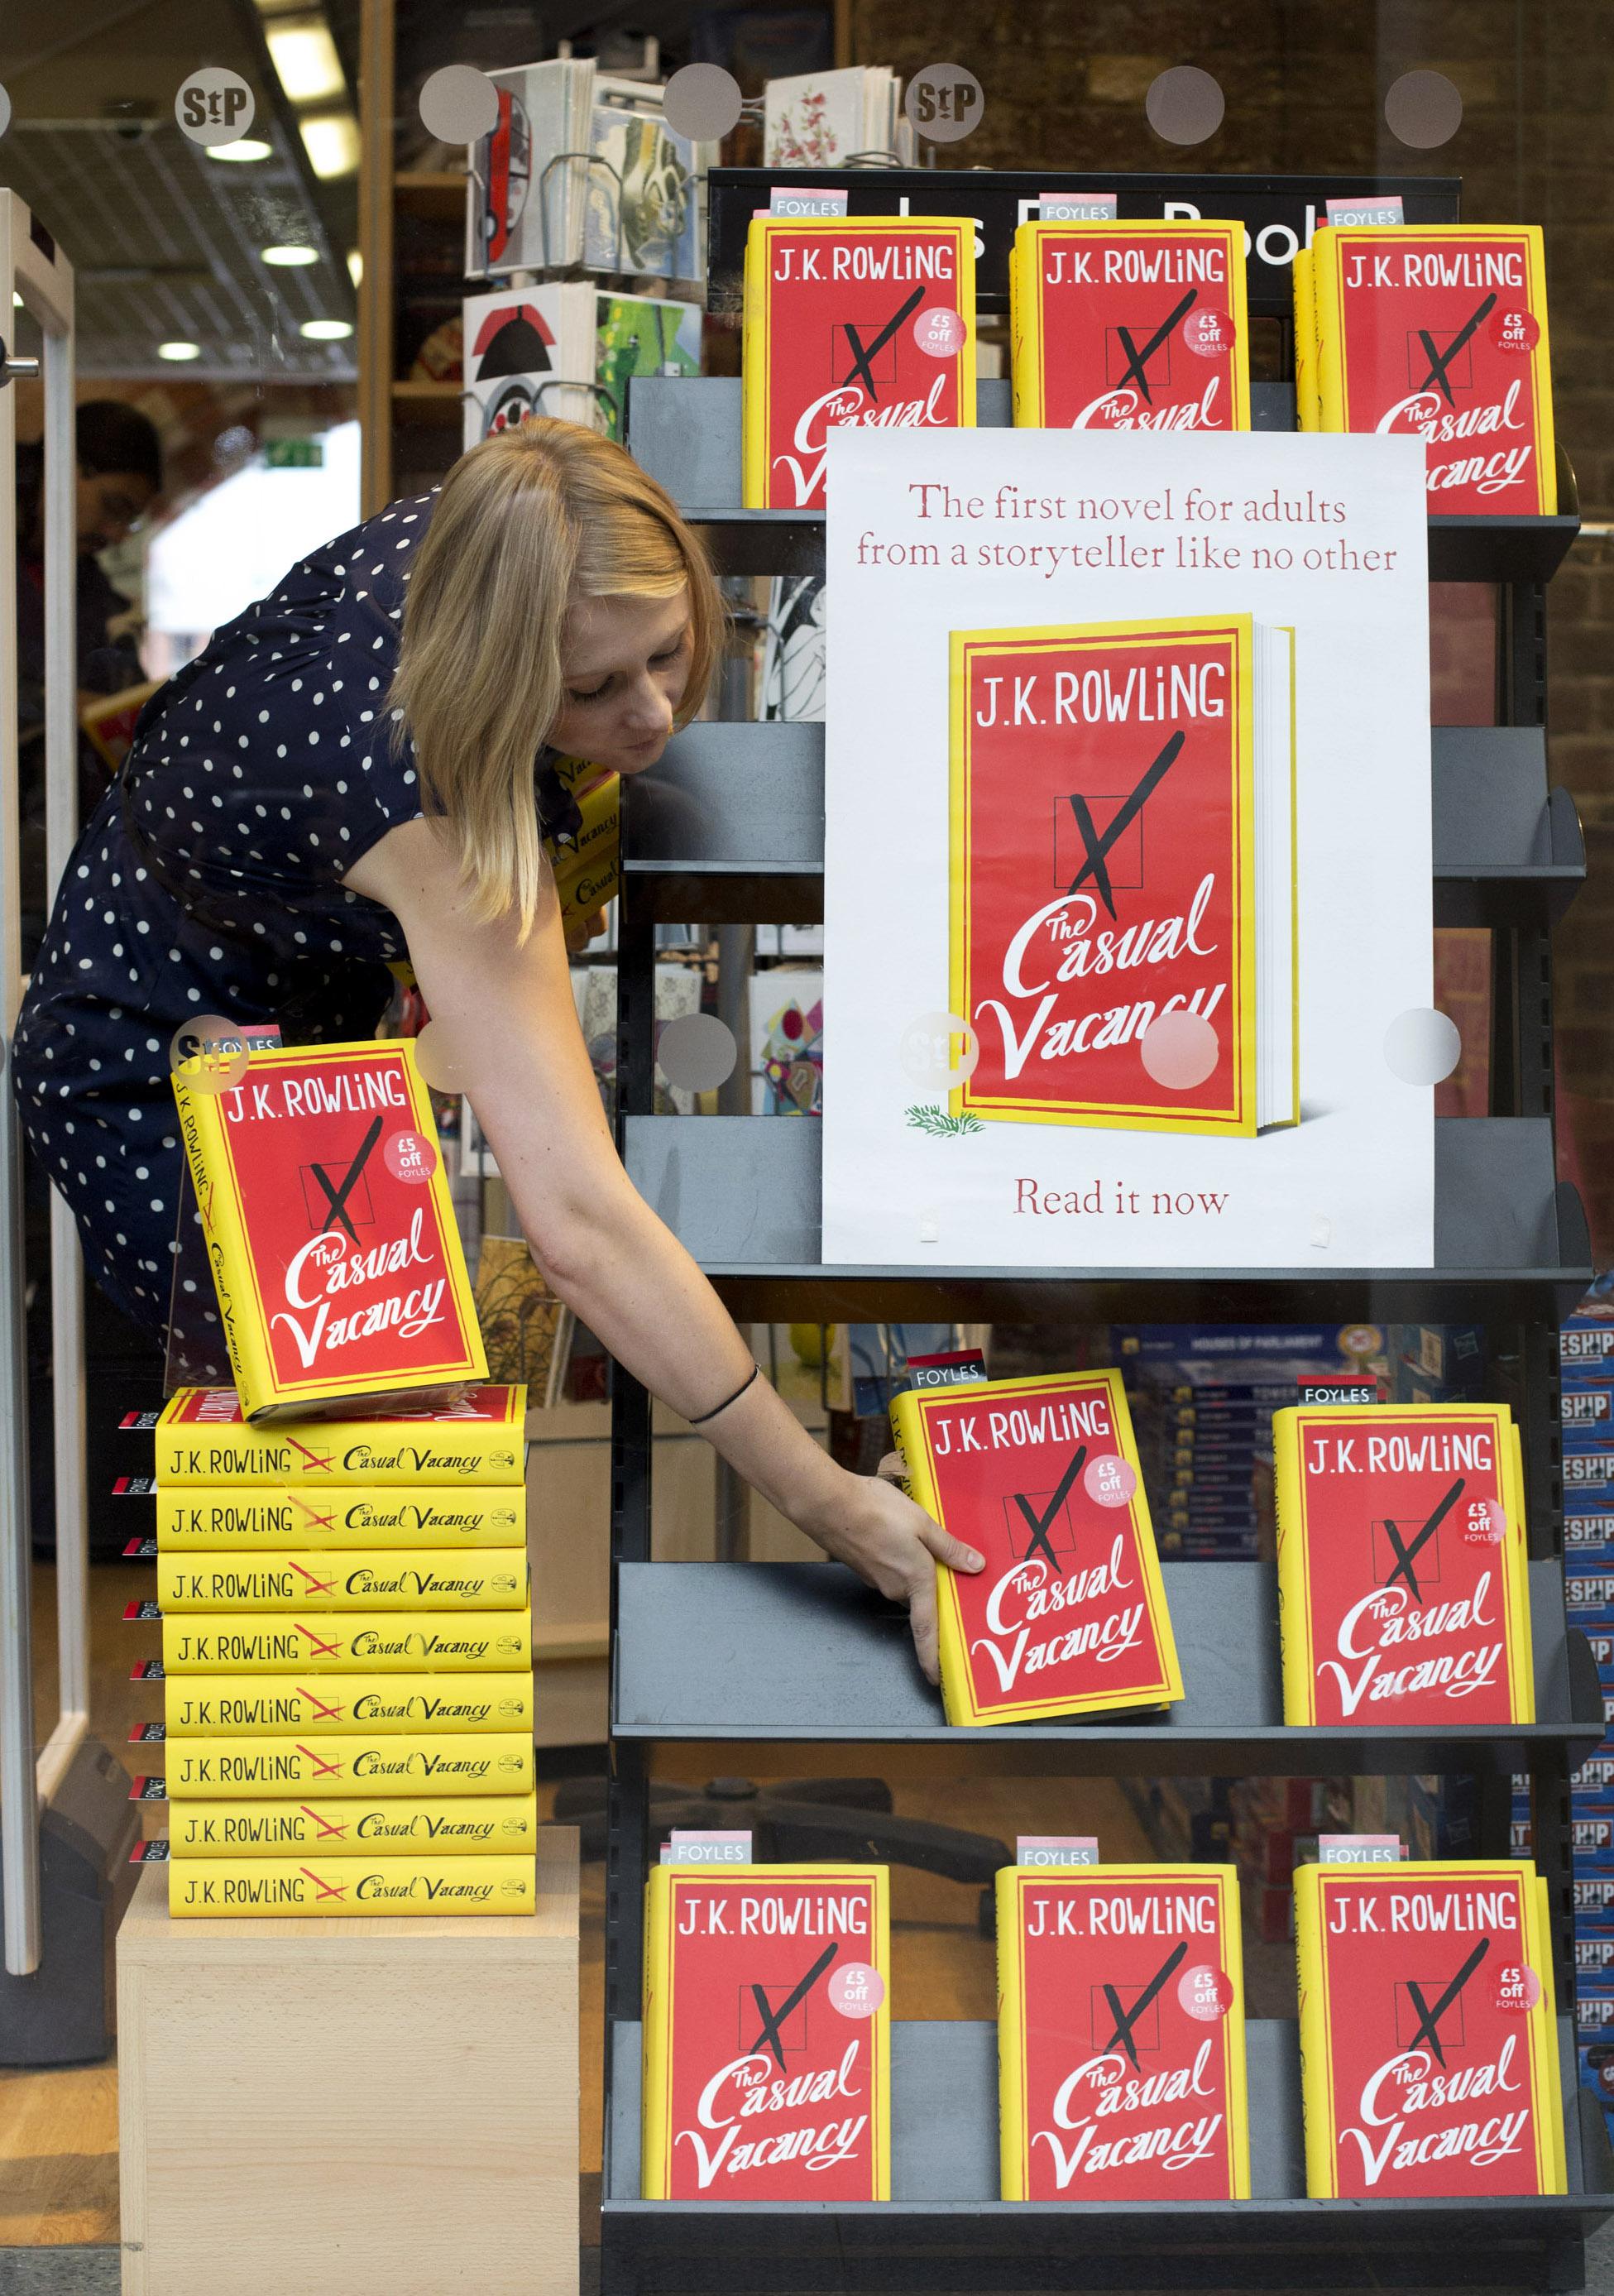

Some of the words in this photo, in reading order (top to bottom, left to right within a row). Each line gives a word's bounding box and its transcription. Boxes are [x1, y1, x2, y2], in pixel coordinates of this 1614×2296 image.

[777, 201, 839, 217] FOYLES
[1046, 207, 1109, 220] FOYLES
[1334, 211, 1396, 226] FOYLES
[932, 314, 950, 328] £5
[1199, 315, 1217, 328] £5
[1503, 314, 1521, 327] £5
[928, 328, 951, 342] off
[1198, 329, 1221, 342] off
[1502, 327, 1525, 341] off
[922, 341, 955, 352] FOYLES
[1195, 343, 1228, 352] FOYLES
[1497, 341, 1530, 351] FOYLES
[826, 397, 856, 416] The
[1101, 400, 1130, 419] The
[1404, 402, 1433, 422] The
[1425, 445, 1532, 495] cancy
[909, 484, 984, 518] The
[995, 486, 1066, 520] first
[1078, 489, 1175, 521] novel
[1185, 487, 1233, 522] for
[1243, 489, 1347, 523] adults
[857, 531, 941, 565] from
[951, 544, 968, 566] a
[978, 535, 1165, 578] storyteller
[1176, 536, 1241, 568] like
[1252, 548, 1293, 569] no
[1303, 539, 1397, 571] other
[1003, 873, 1219, 999] Casual
[1046, 911, 1086, 942] The
[398, 1138, 416, 1153] £5
[400, 1152, 422, 1167] off
[398, 1166, 431, 1178] FOYLES
[1013, 1177, 1104, 1216] Read
[1116, 1181, 1140, 1215] it
[1151, 1191, 1230, 1215] now
[285, 1207, 434, 1309] Casual
[310, 1244, 340, 1267] The
[271, 1278, 446, 1368] Vacancy
[917, 1366, 979, 1386] FOYLES
[1305, 1388, 1370, 1403] FOYLES
[342, 1445, 404, 1471] Casual
[408, 1447, 482, 1474] Vacancy
[1098, 1462, 1116, 1478] £5
[1099, 1475, 1121, 1490] off
[1098, 1490, 1131, 1503] FOYLES
[344, 1503, 406, 1529] Casual
[409, 1505, 484, 1532] Vacancy
[1468, 1503, 1487, 1517] £5
[1468, 1517, 1491, 1531] off
[1464, 1533, 1498, 1542] FOYLES
[345, 1569, 406, 1595] Casual
[411, 1570, 485, 1598] Vacancy
[986, 1534, 1134, 1635] Casual
[1012, 1572, 1042, 1594] The
[1337, 1570, 1496, 1660] Casual
[1370, 1599, 1400, 1619] The
[350, 1631, 412, 1656] Casual
[414, 1632, 490, 1660] Vacancy
[970, 1603, 1144, 1693] Vacancy
[1316, 1642, 1503, 1717] Vacancy
[352, 1694, 414, 1720] Casual
[416, 1696, 491, 1723] Vacancy
[352, 1751, 412, 1777] Casual
[416, 1752, 491, 1779] Vacancy
[357, 1813, 418, 1838] Casual
[419, 1814, 495, 1841] Vacancy
[678, 1846, 744, 1860] FOYLES
[1024, 1851, 1090, 1866] FOYLES
[1326, 1848, 1392, 1863] FOYLES
[356, 1874, 417, 1901] Casual
[419, 1877, 494, 1901] Vacancy
[845, 1971, 865, 1985] £5
[1194, 1973, 1213, 1987] £5
[1500, 1968, 1520, 1982] £5
[844, 1985, 868, 2001] off
[1195, 1988, 1218, 2003] off
[1500, 1983, 1523, 1999] off
[839, 2002, 874, 2012] FOYLES
[1190, 2005, 1225, 2014] FOYLES
[1496, 2000, 1530, 2009] FOYLES
[732, 2066, 762, 2087] The
[1087, 2066, 1118, 2088] The
[1359, 2034, 1521, 2126] Casual
[1392, 2063, 1423, 2085] The
[697, 2039, 862, 2129] Casual
[1052, 2038, 1216, 2130] Casual
[674, 2115, 868, 2189] Vacancy
[1031, 2113, 1223, 2189] Vacancy
[1339, 2109, 1529, 2186] Vacancy
